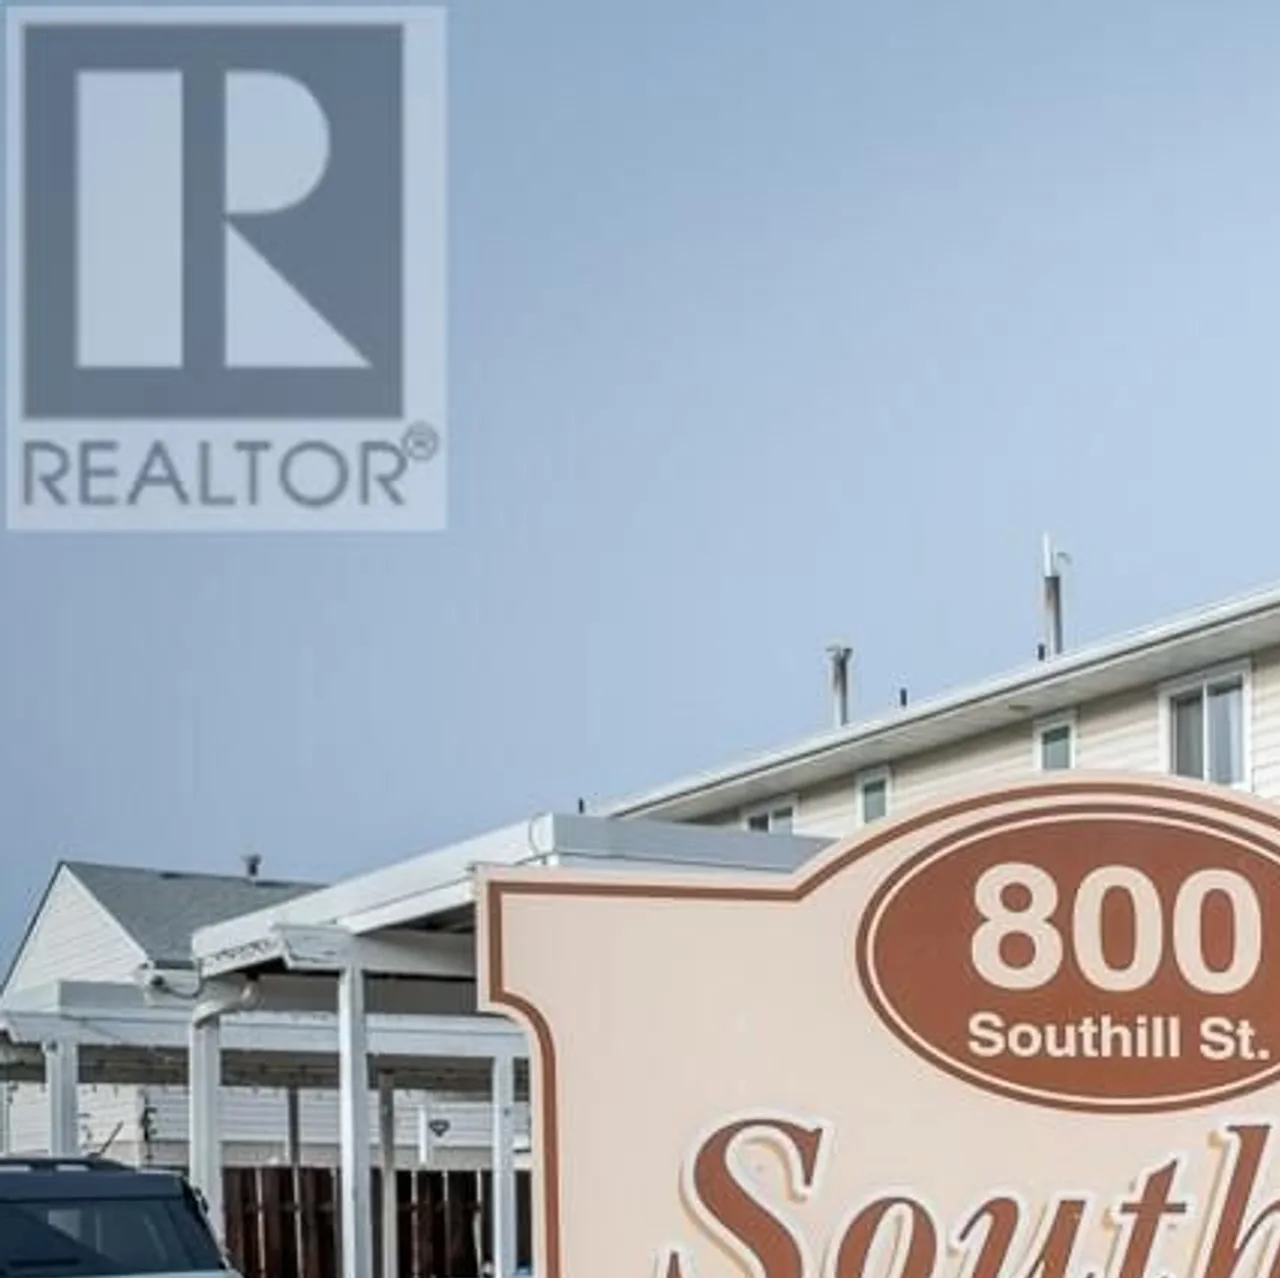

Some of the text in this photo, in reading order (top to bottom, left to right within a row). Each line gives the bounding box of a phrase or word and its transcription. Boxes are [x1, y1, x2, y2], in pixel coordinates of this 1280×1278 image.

[970, 861, 1263, 995] 800
[967, 1012, 1271, 1061] Southill St.
